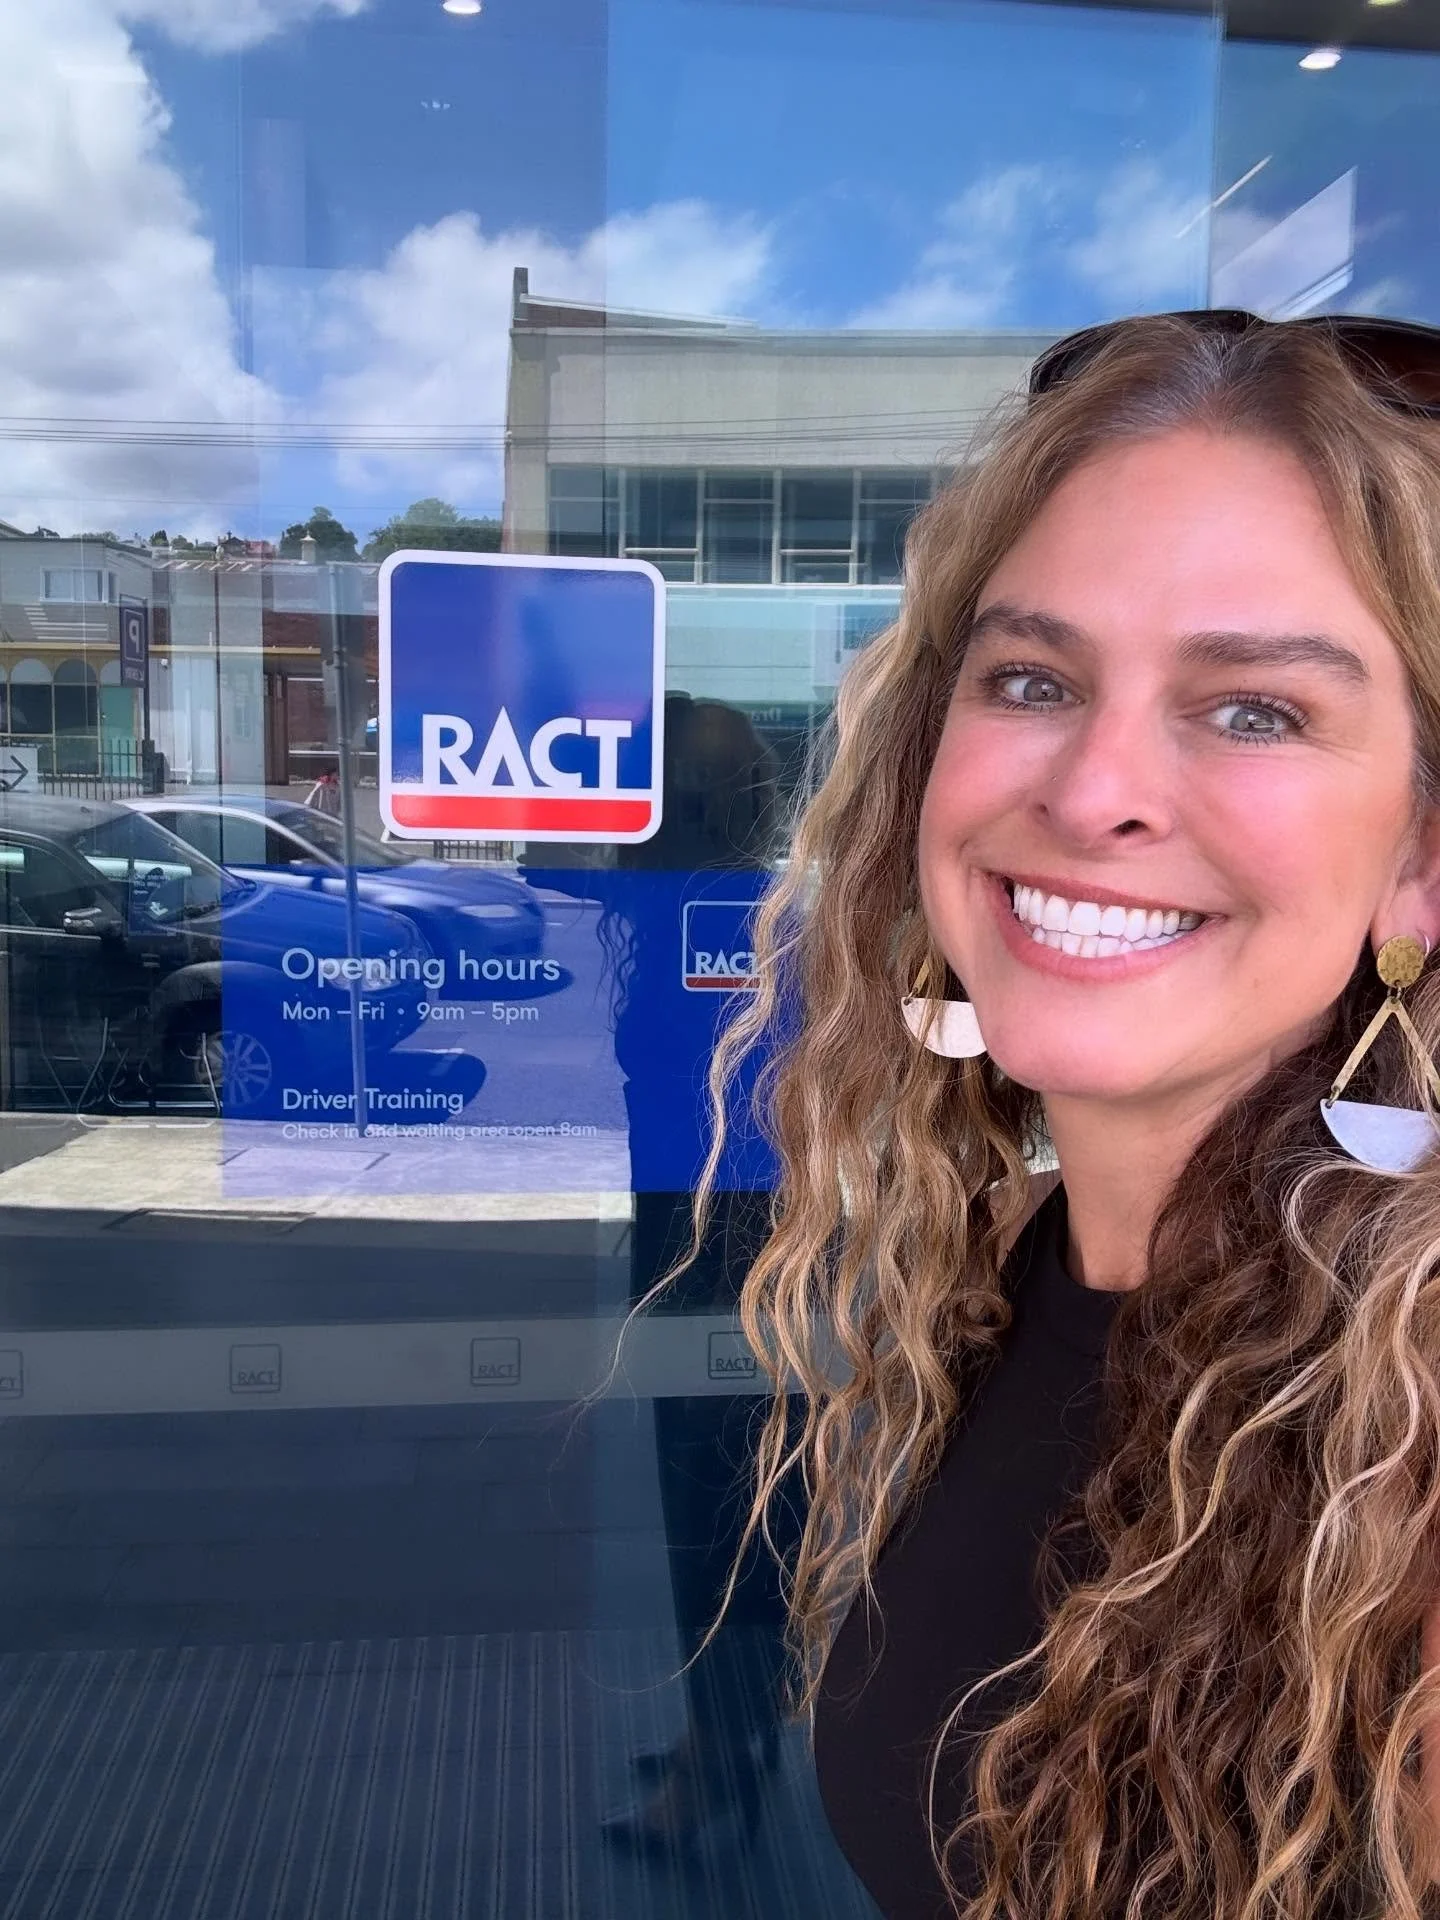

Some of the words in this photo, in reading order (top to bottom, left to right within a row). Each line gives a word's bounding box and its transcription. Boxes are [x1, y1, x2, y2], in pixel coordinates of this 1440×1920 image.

[422, 706, 633, 790] RACT
[282, 947, 446, 989] Opening
[459, 949, 561, 981] hours
[283, 1000, 330, 1020] Mon
[358, 1000, 385, 1020] Fri
[416, 1001, 465, 1021] 9am
[492, 1001, 540, 1025] 5pm
[282, 1087, 358, 1111] Driver
[363, 1087, 464, 1115] Training
[282, 1123, 339, 1139] Check
[344, 1124, 359, 1138] in
[364, 1123, 398, 1138] and
[402, 1123, 466, 1141] waiting
[469, 1125, 508, 1137] area
[512, 1124, 556, 1140] open
[559, 1121, 597, 1137] 8am
[715, 1356, 754, 1370] RACT
